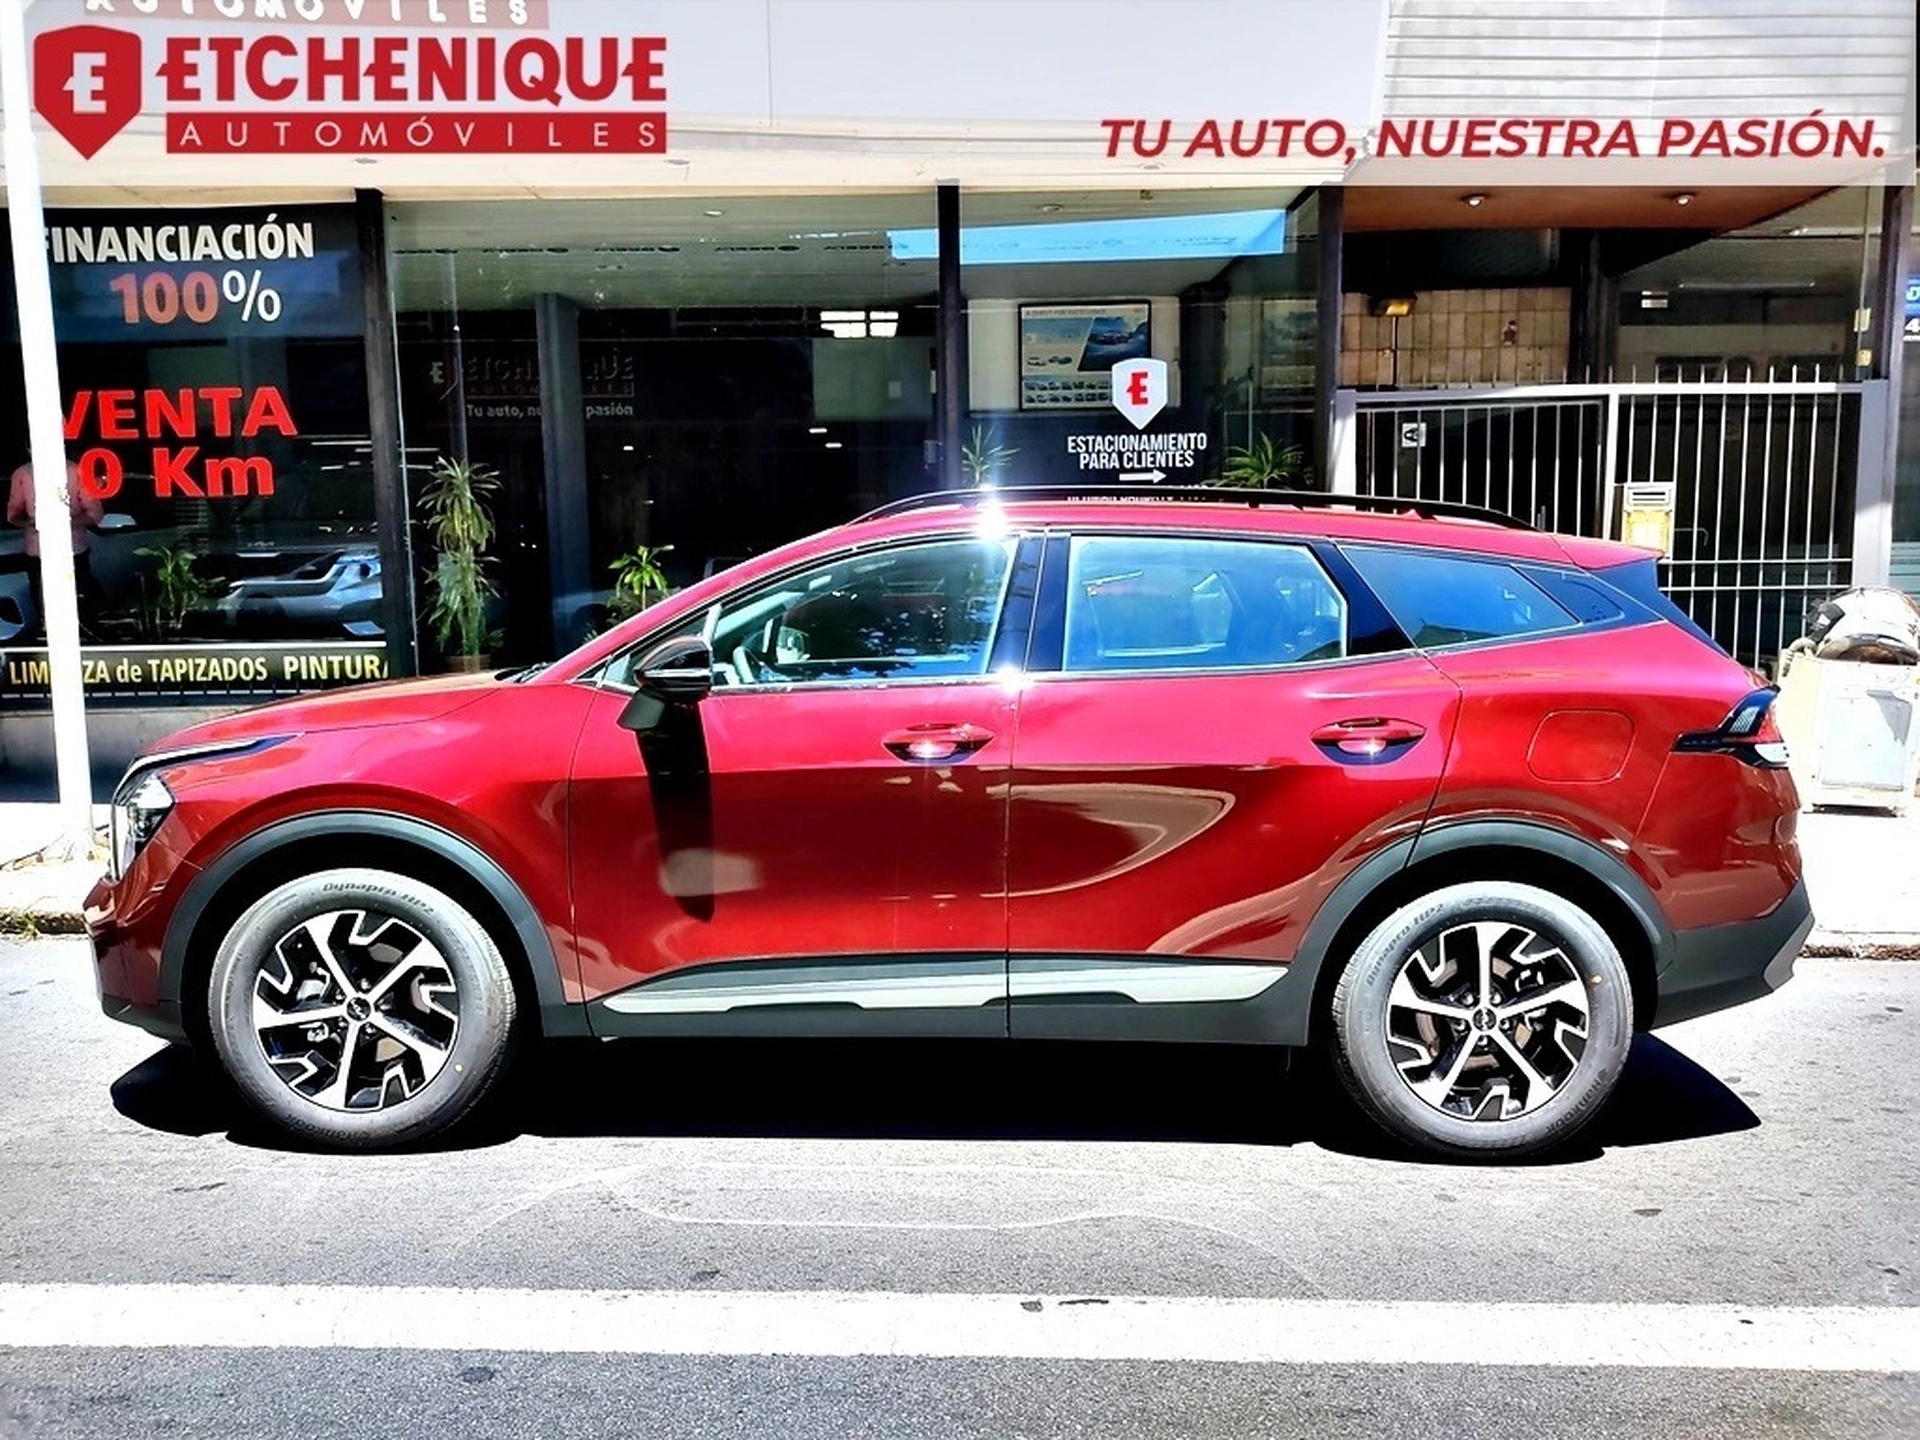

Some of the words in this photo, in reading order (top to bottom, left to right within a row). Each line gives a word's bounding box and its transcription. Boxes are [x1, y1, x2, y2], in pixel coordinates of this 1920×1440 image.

[46, 213, 314, 264] INANCIACIÓN
[110, 269, 282, 324] 100%
[63, 387, 297, 438] VENTA
[467, 404, 483, 417] Tu
[487, 403, 524, 419] auto,
[586, 402, 633, 419] pasión
[1068, 433, 1207, 452] ESTACIONAMIENTO
[1080, 452, 1119, 468] PARA
[1123, 450, 1194, 468] CLIENTES
[152, 447, 274, 498] Km
[116, 658, 142, 683] de
[147, 656, 268, 683] TAPIZADOS
